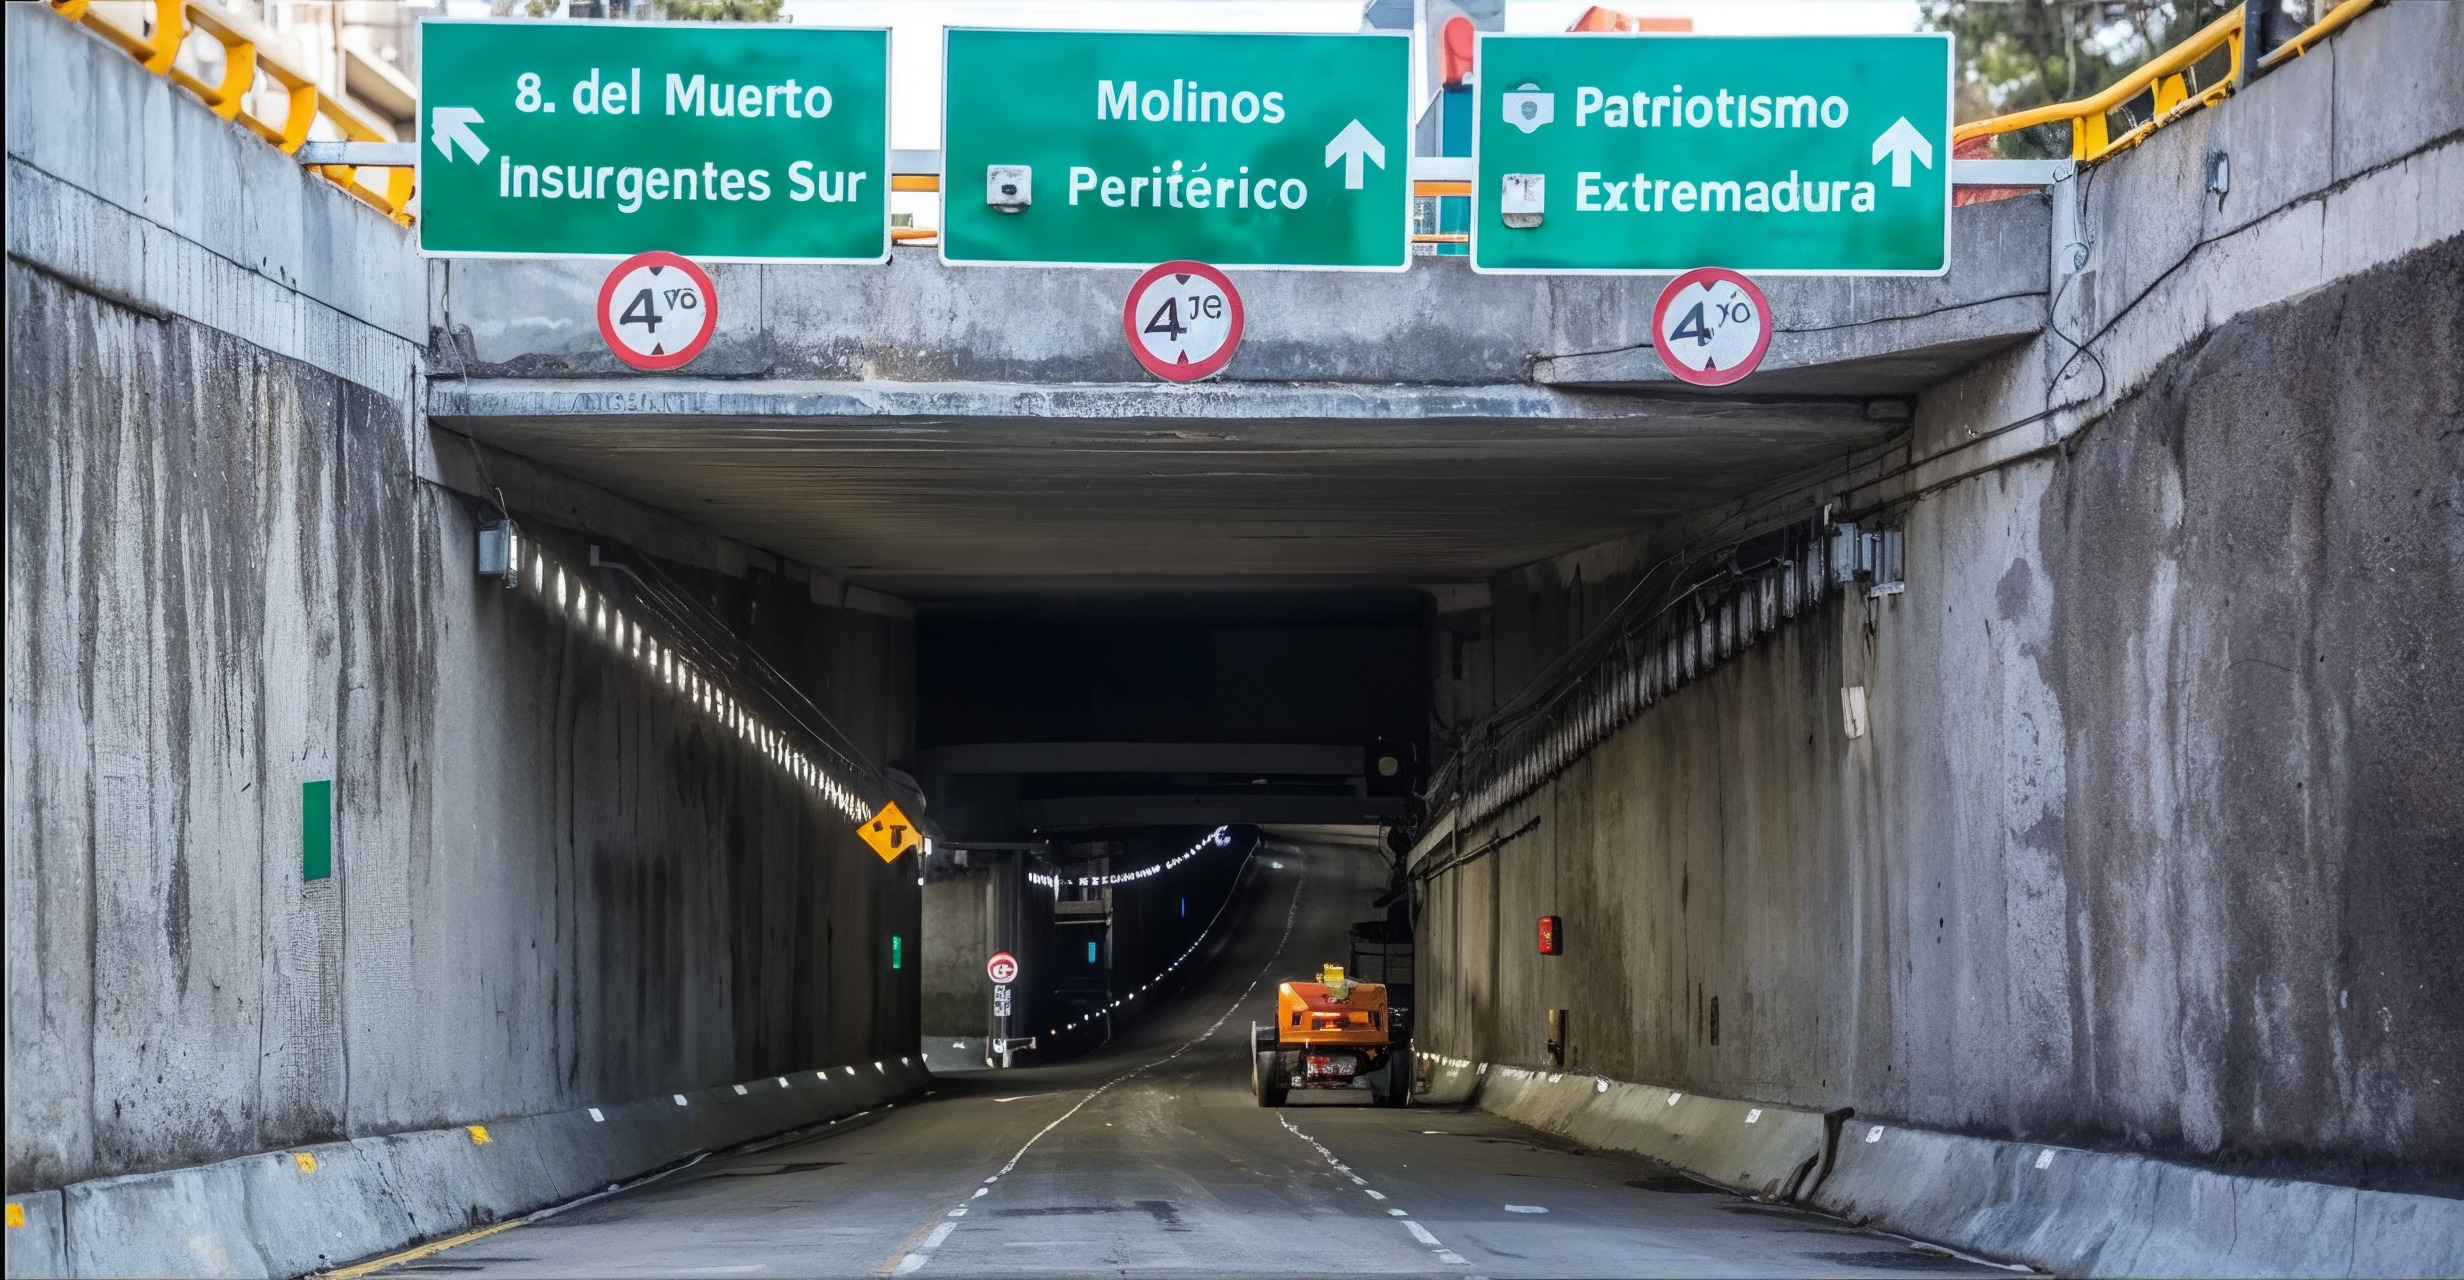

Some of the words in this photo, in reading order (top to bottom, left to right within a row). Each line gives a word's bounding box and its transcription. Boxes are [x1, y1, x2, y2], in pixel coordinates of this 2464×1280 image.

[516, 73, 554, 112] 8.
[573, 69, 639, 114] del
[667, 74, 831, 117] Muerto
[1098, 79, 1284, 123] Molinos
[501, 156, 770, 213] Insurgentes
[789, 161, 866, 202] Sur
[1577, 170, 1874, 212] Extremadura
